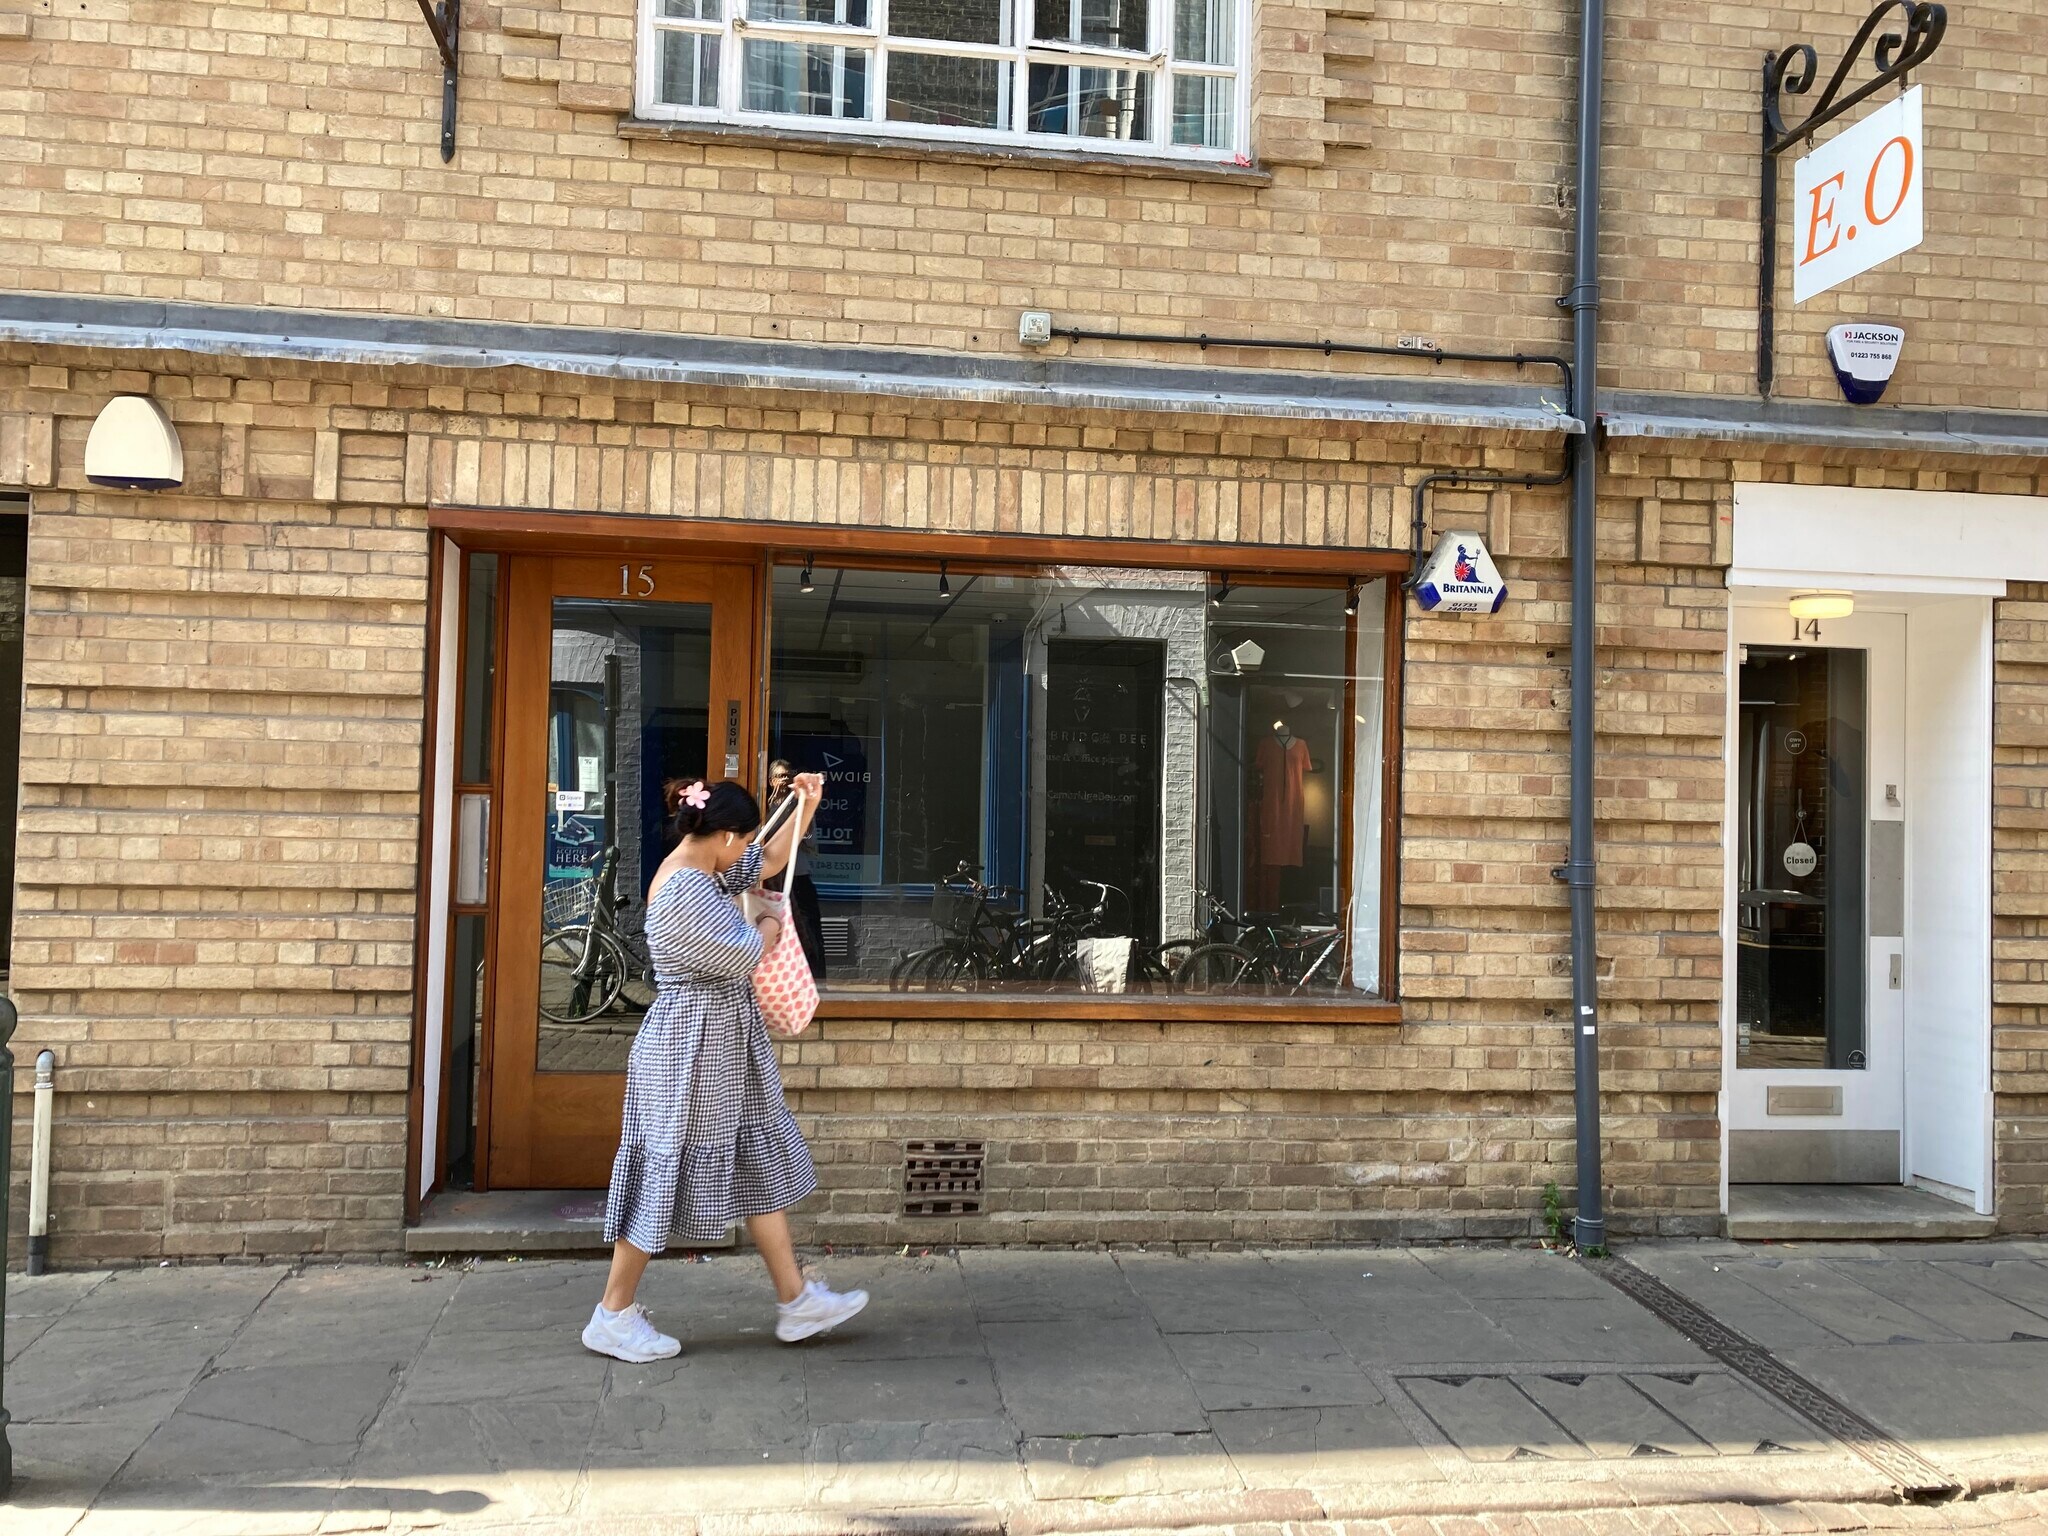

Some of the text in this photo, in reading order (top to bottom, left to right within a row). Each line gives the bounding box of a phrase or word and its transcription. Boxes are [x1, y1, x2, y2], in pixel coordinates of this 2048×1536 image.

[1799, 135, 1915, 266] E.O
[1853, 332, 1898, 341] JACKSON
[619, 564, 655, 597] 15
[1442, 583, 1494, 594] BRITANNIA
[1792, 617, 1821, 641] 14
[729, 708, 738, 746] PUSH
[1119, 733, 1148, 744] BEE
[556, 853, 588, 863] HERE
[1786, 856, 1814, 865] Closed
